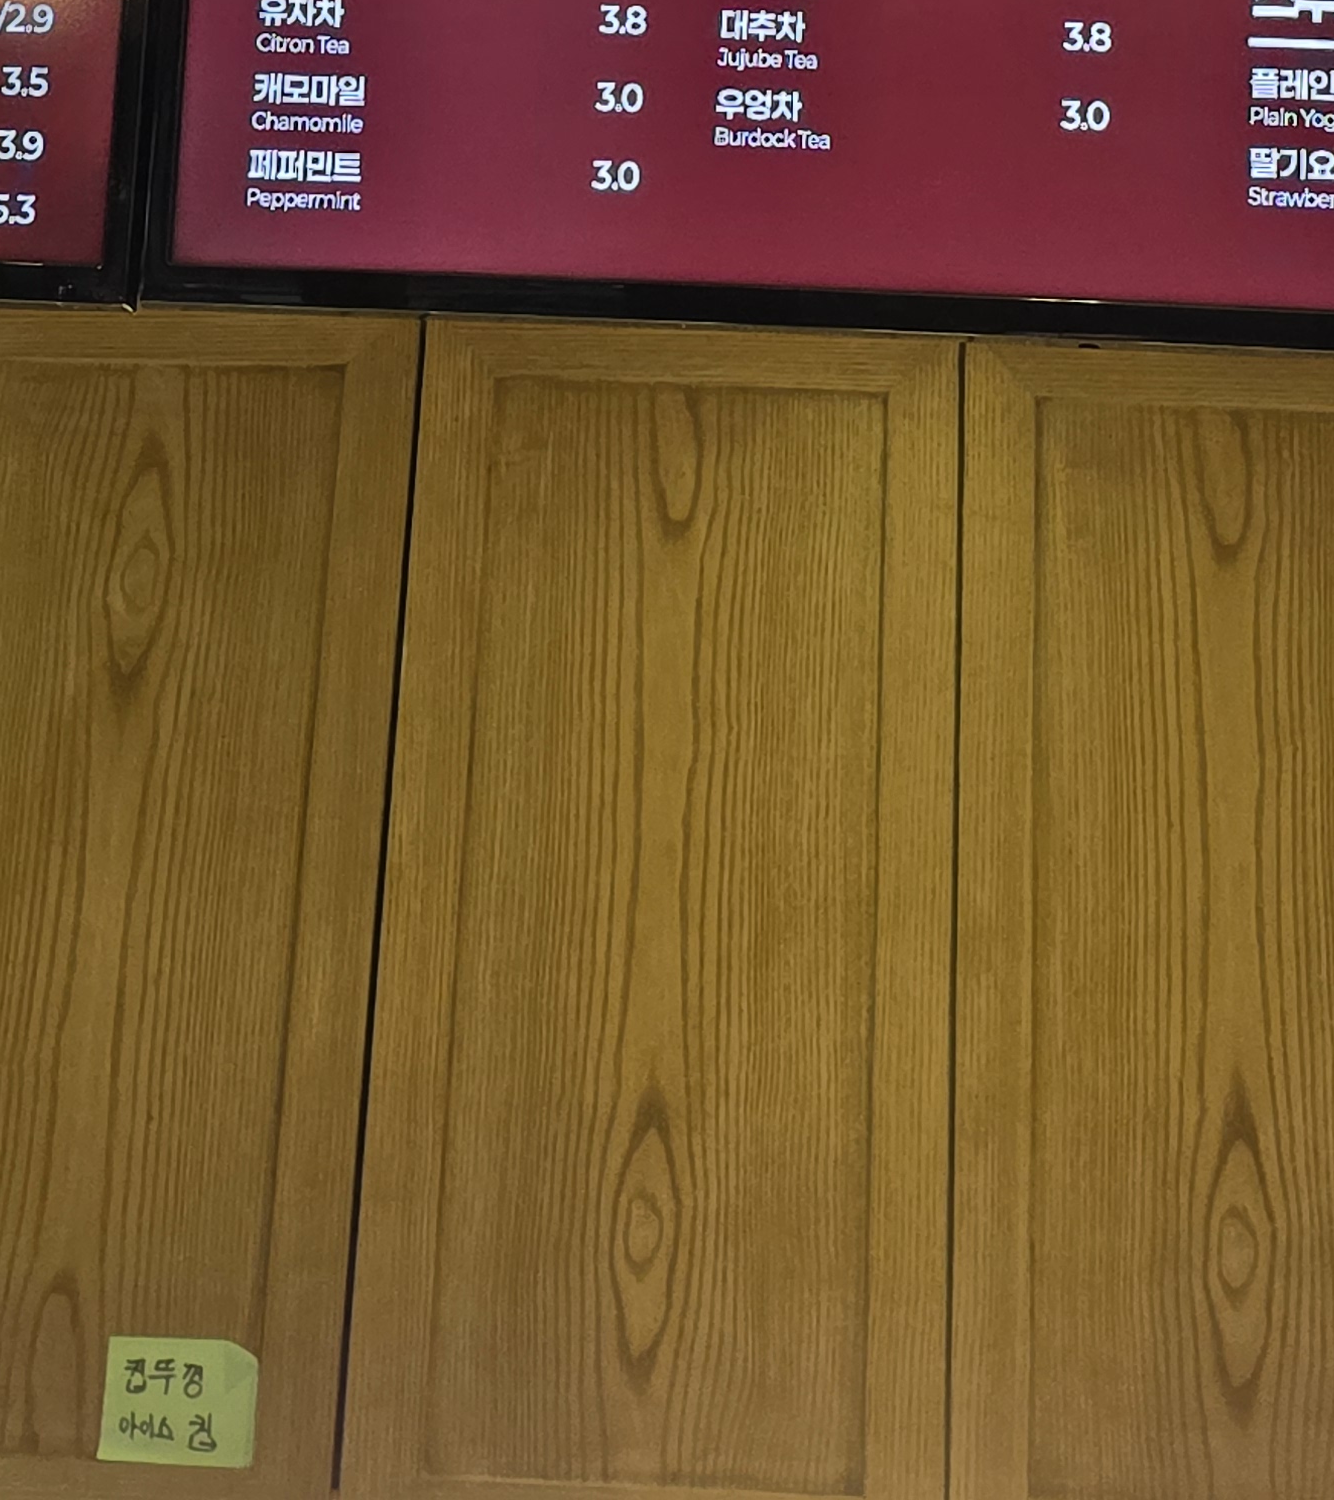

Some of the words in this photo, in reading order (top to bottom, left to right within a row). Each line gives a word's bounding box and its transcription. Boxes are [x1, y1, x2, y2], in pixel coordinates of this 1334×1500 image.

[719, 9, 806, 43] 대추차
[255, 32, 315, 54] Citron
[316, 34, 350, 54] Tea
[252, 72, 365, 107] 캐모마일
[715, 88, 803, 123] 우엉차
[251, 110, 364, 134] Chamomile
[247, 148, 362, 183] 페퍼민트
[246, 187, 361, 212] Peppermint
[118, 1411, 175, 1442] 아이스
